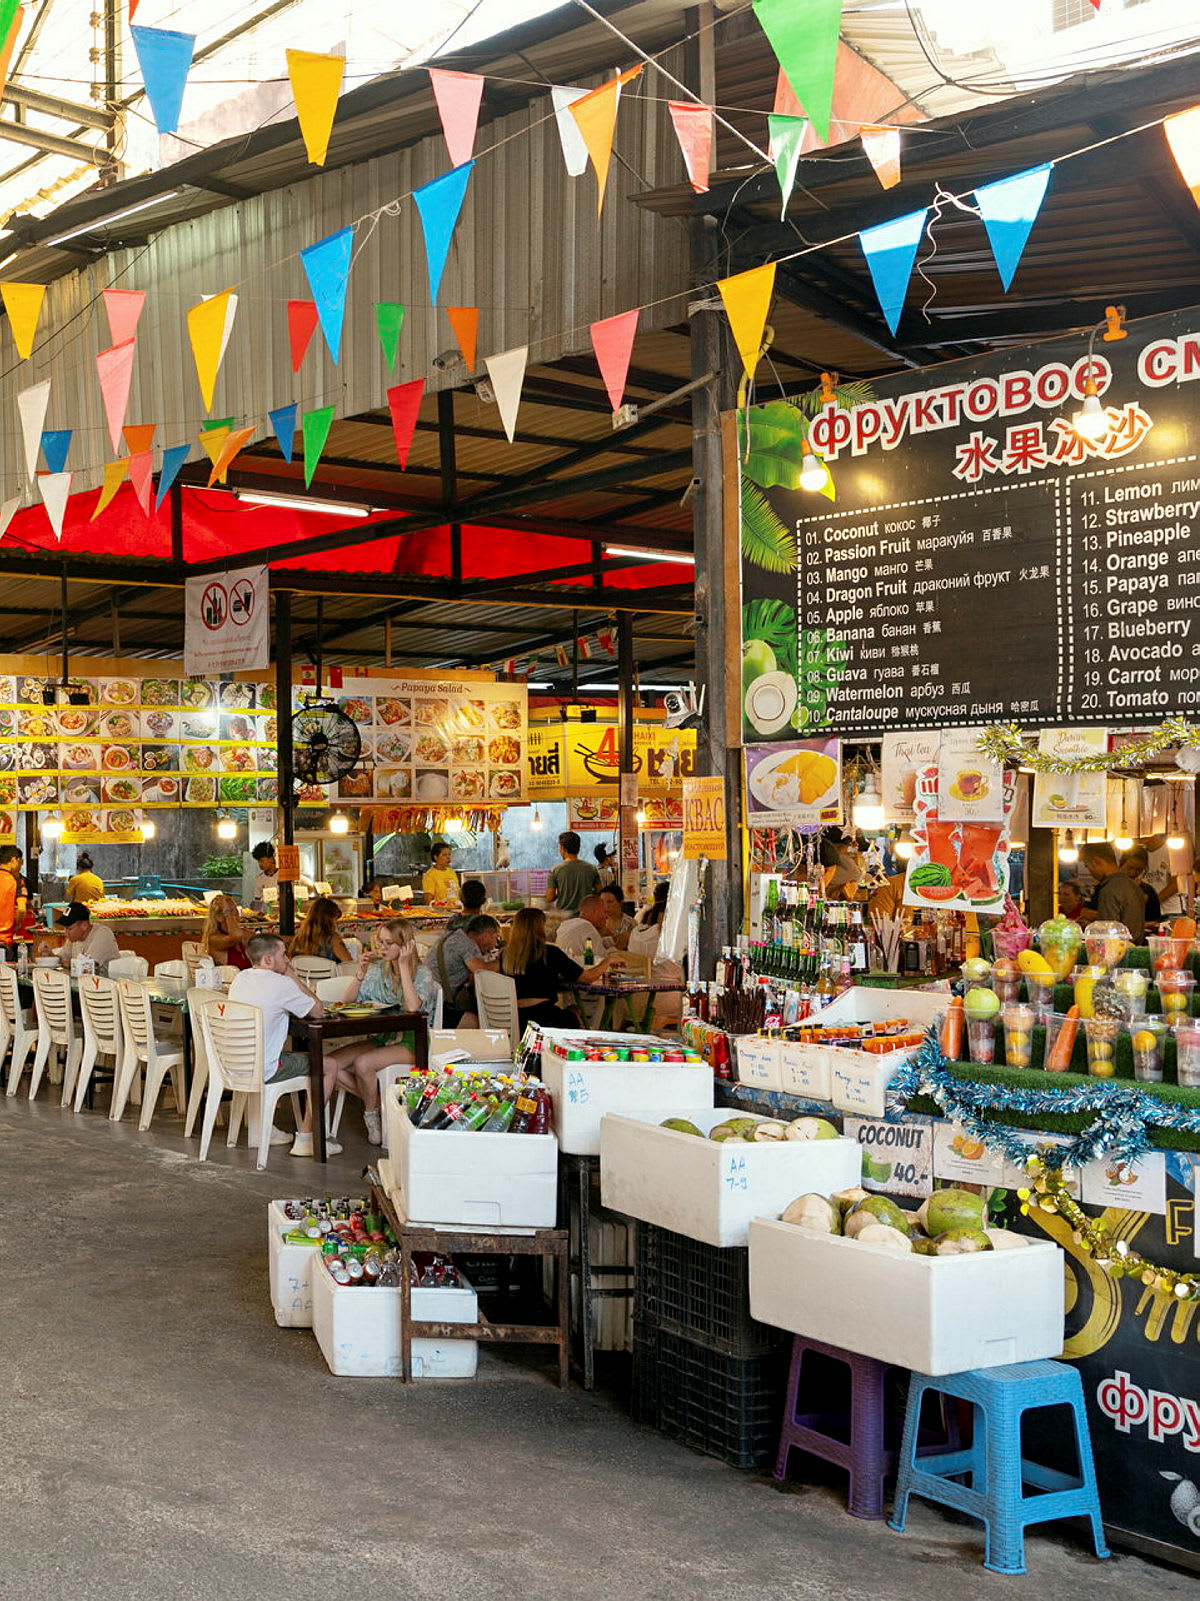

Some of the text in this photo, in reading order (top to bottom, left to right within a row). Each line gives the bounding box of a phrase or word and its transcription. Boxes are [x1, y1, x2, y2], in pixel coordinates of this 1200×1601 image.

[1080, 490, 1100, 506] 11.
[1104, 482, 1162, 504] Lemon
[1081, 501, 1200, 530] 12. Strawberry
[806, 532, 821, 546] 01.
[824, 522, 879, 543] Coconut
[884, 519, 916, 534] кокос
[1082, 522, 1191, 551] 13. Pineapple
[806, 552, 822, 566] 02.
[825, 544, 876, 563] Passion
[880, 538, 911, 555] Fruit
[917, 530, 974, 551] маракуйя
[1082, 558, 1102, 574] 14.
[1106, 551, 1169, 571] Orange
[806, 572, 822, 586] 03.
[826, 566, 868, 583] Mango
[874, 562, 908, 578] манго
[1082, 580, 1102, 595] 15.
[1106, 573, 1169, 595] Papaya
[806, 592, 822, 605] 04.
[826, 586, 873, 604] Dragon
[876, 579, 907, 597] Fruit
[913, 573, 970, 595] драконий
[973, 570, 1011, 588] фрукт
[807, 611, 823, 625] 05.
[826, 605, 864, 626] Apple
[869, 603, 910, 619] яблоко
[1083, 602, 1102, 618] 16.
[1107, 598, 1158, 617] Grape
[807, 631, 822, 645] 06.
[826, 627, 875, 642] Banana
[882, 623, 916, 638] банан
[1084, 619, 1191, 641] 17. Blueberry
[807, 651, 822, 664] 07.
[826, 646, 854, 662] Kiwi
[860, 648, 886, 660] киви
[1084, 648, 1104, 663] 18.
[1108, 641, 1183, 662] Avocado
[807, 671, 823, 684] 08.
[826, 667, 867, 682] Guava
[874, 666, 905, 683] гуава
[1084, 671, 1103, 686] 19.
[1108, 665, 1161, 685] Carrot
[401, 683, 463, 694] Papaya Salad
[807, 690, 823, 704] 09.
[826, 684, 903, 701] Watermelon
[910, 682, 945, 699] арбуз
[1081, 694, 1102, 709] 20.
[1106, 689, 1169, 707] Tomato
[808, 710, 823, 723] 10.
[826, 706, 899, 722] Cantaloupe
[905, 703, 967, 720] мускусная
[970, 702, 1004, 716] дыня
[858, 1125, 924, 1149] COCONUT
